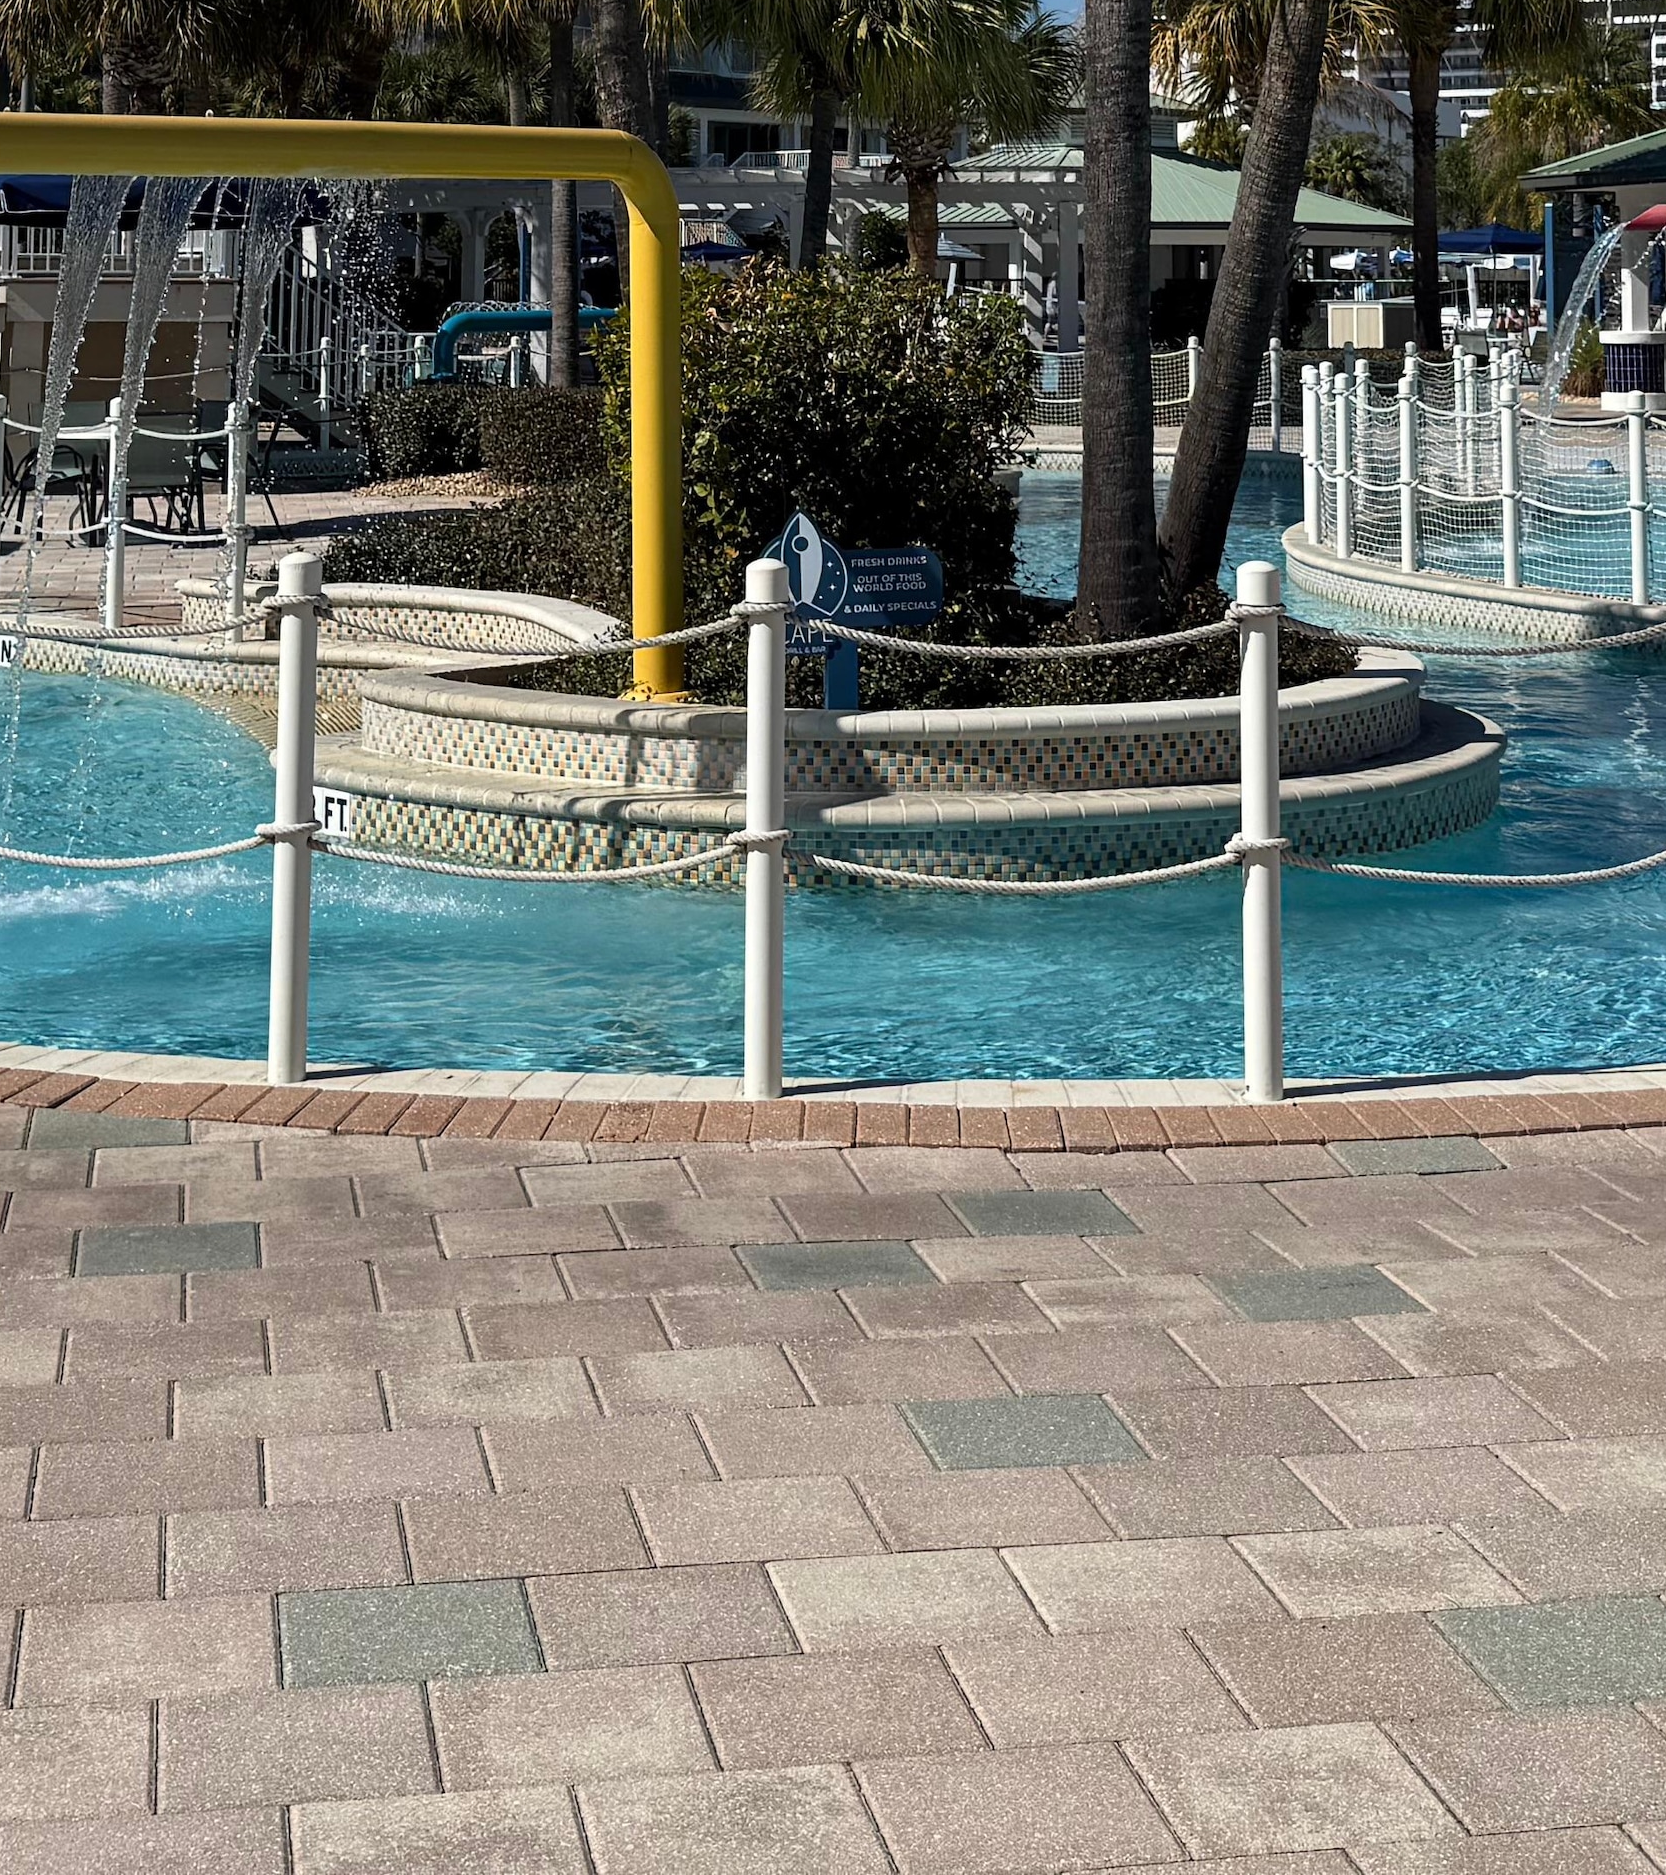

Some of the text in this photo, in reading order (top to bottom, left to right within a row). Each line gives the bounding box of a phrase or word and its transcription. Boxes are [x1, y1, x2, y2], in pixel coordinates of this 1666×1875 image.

[851, 555, 927, 568] FRESH DRINKS
[857, 572, 922, 584] OUT OF THIS
[853, 581, 927, 593] WORLD FOOD
[844, 600, 937, 614] & DAILY SPECIALS
[324, 795, 348, 832] FT.
